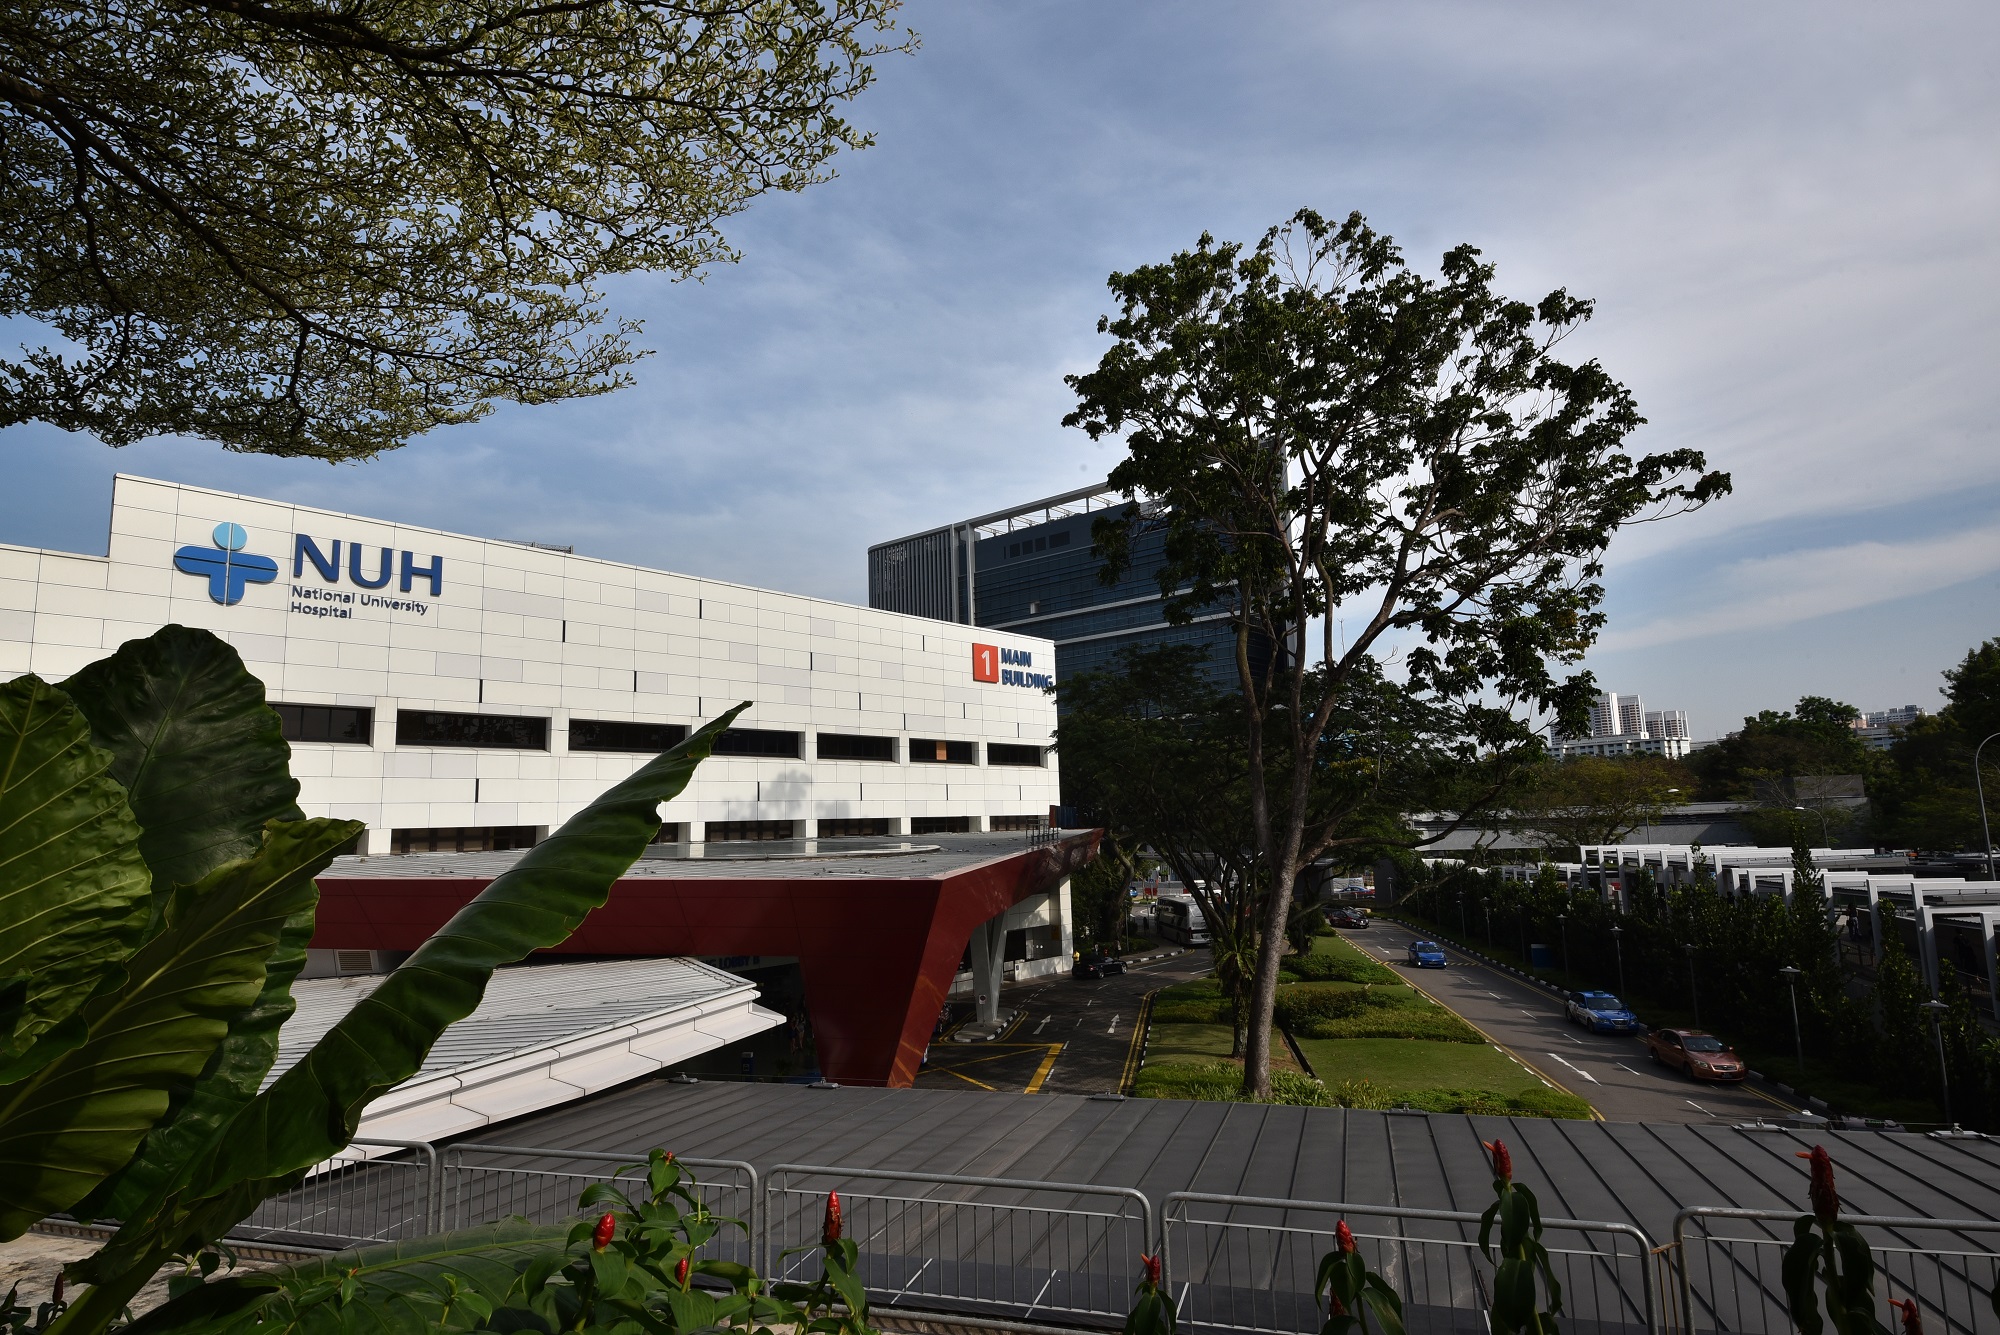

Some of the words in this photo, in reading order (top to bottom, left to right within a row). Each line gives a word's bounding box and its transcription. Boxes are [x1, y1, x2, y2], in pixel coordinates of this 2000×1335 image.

[293, 533, 443, 596] NUH
[292, 586, 355, 603] National
[361, 595, 428, 615] University
[290, 602, 352, 619] Hospital
[981, 650, 990, 675] 1
[1001, 648, 1031, 667] MAIN
[1001, 669, 1053, 688] BUILDING
[719, 956, 750, 969] LOBBY
